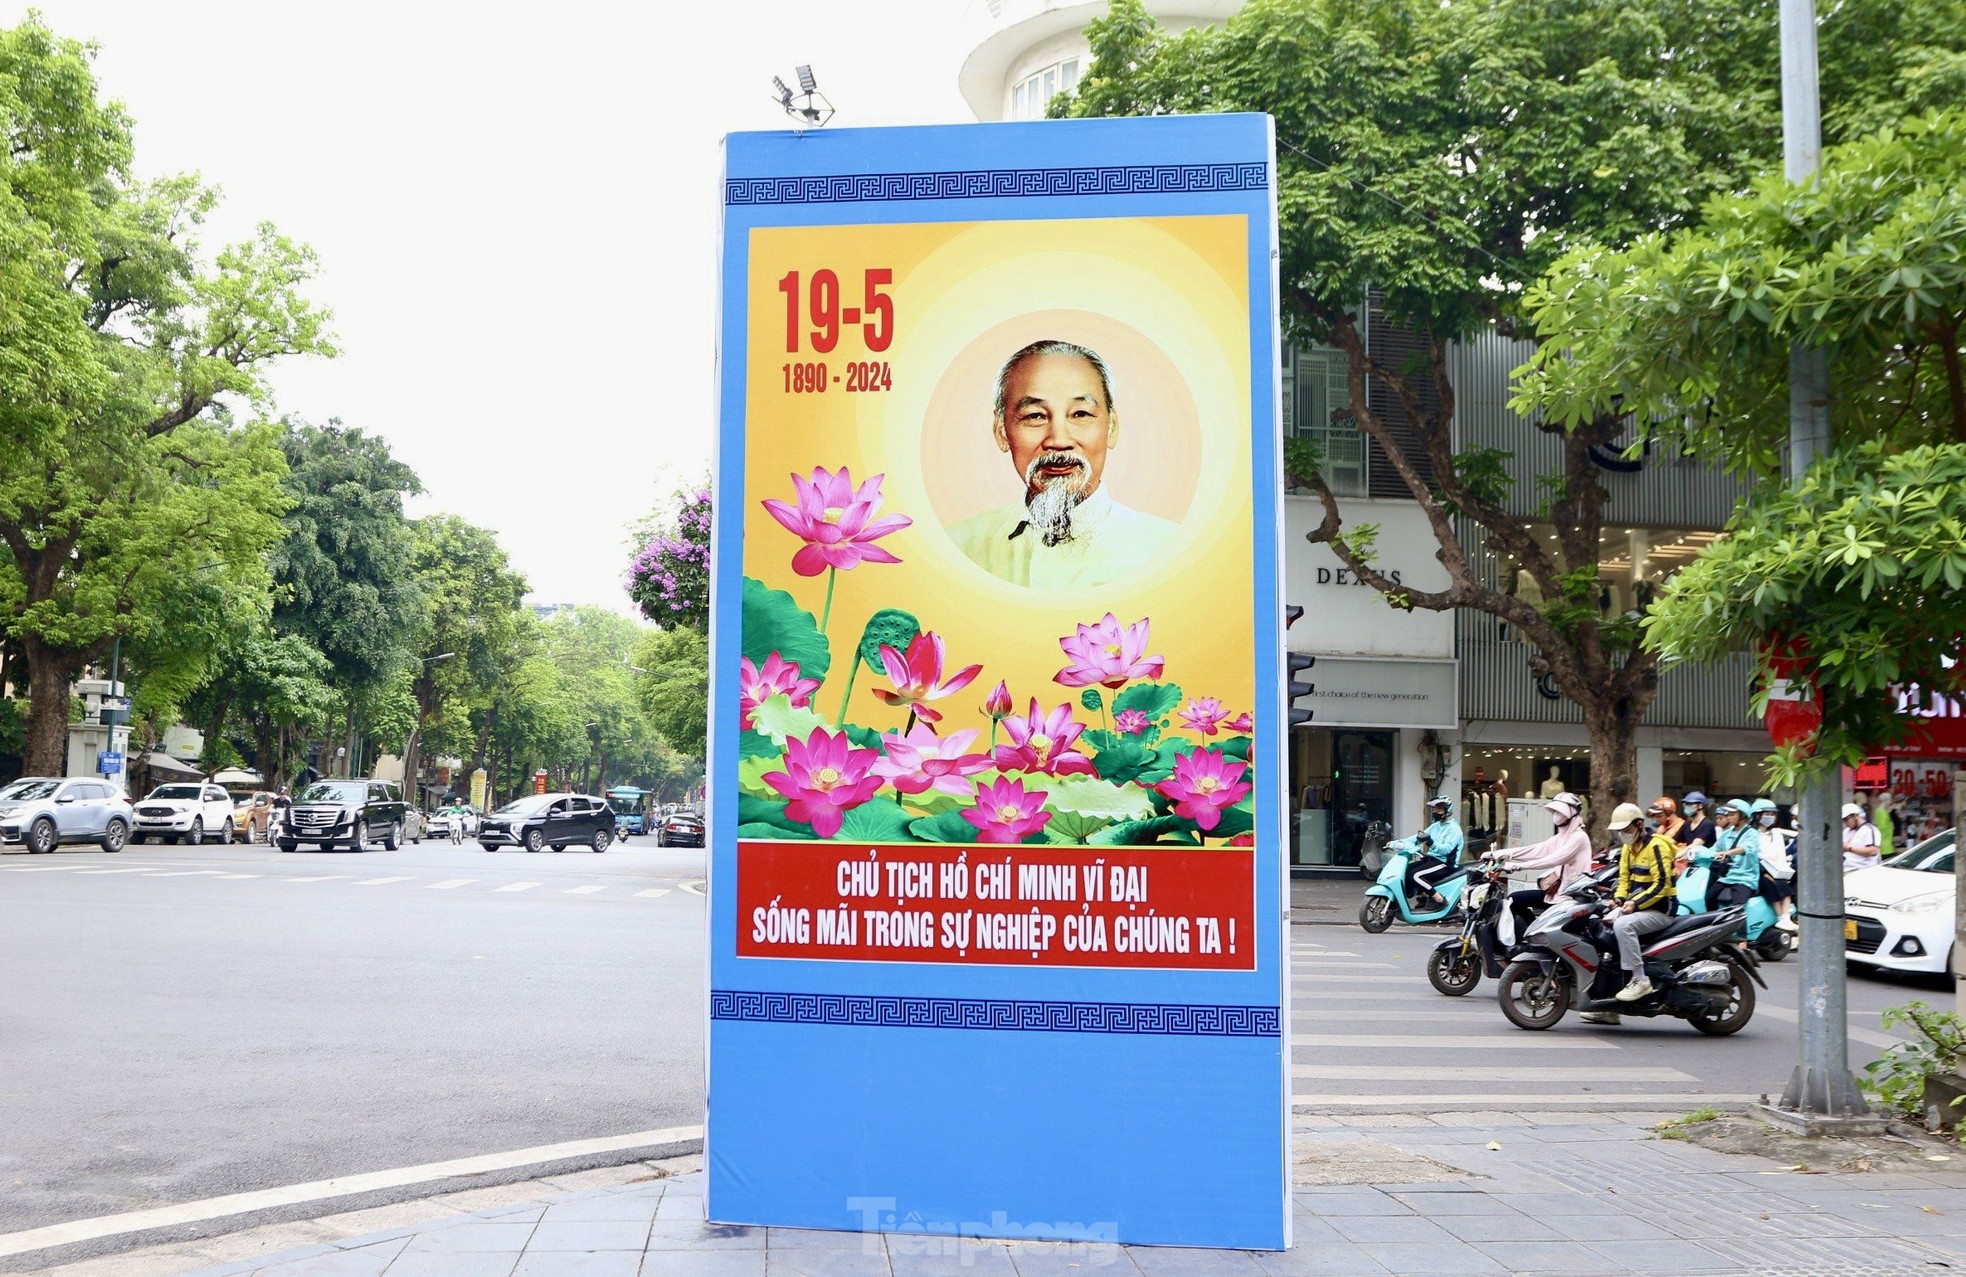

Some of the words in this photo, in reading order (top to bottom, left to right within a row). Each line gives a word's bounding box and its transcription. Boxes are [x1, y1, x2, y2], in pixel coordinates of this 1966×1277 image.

[779, 268, 894, 353] 19-5
[783, 362, 827, 393] 1890
[846, 361, 892, 392] 2024
[1327, 689, 1350, 699] choice
[1351, 690, 1359, 699] of
[1361, 691, 1373, 700] the
[1374, 692, 1389, 700] new
[1391, 692, 1429, 701] generation
[837, 849, 879, 897] CHỦ
[886, 861, 933, 906] TỊCH
[940, 851, 968, 900] HỒ
[975, 856, 1011, 900] CHÍ
[1018, 864, 1076, 901] MINH
[1083, 858, 1105, 902] VĨ
[1110, 865, 1147, 910] ĐẠI
[752, 895, 810, 944] SỐNG
[816, 902, 857, 946] MÃI
[864, 910, 934, 948] TRONG
[941, 909, 972, 957] SỰ
[976, 906, 1057, 959] NGHIỆP
[1063, 902, 1108, 952] CỦA
[1114, 908, 1190, 954] CHÚNG
[1196, 917, 1222, 954] TA
